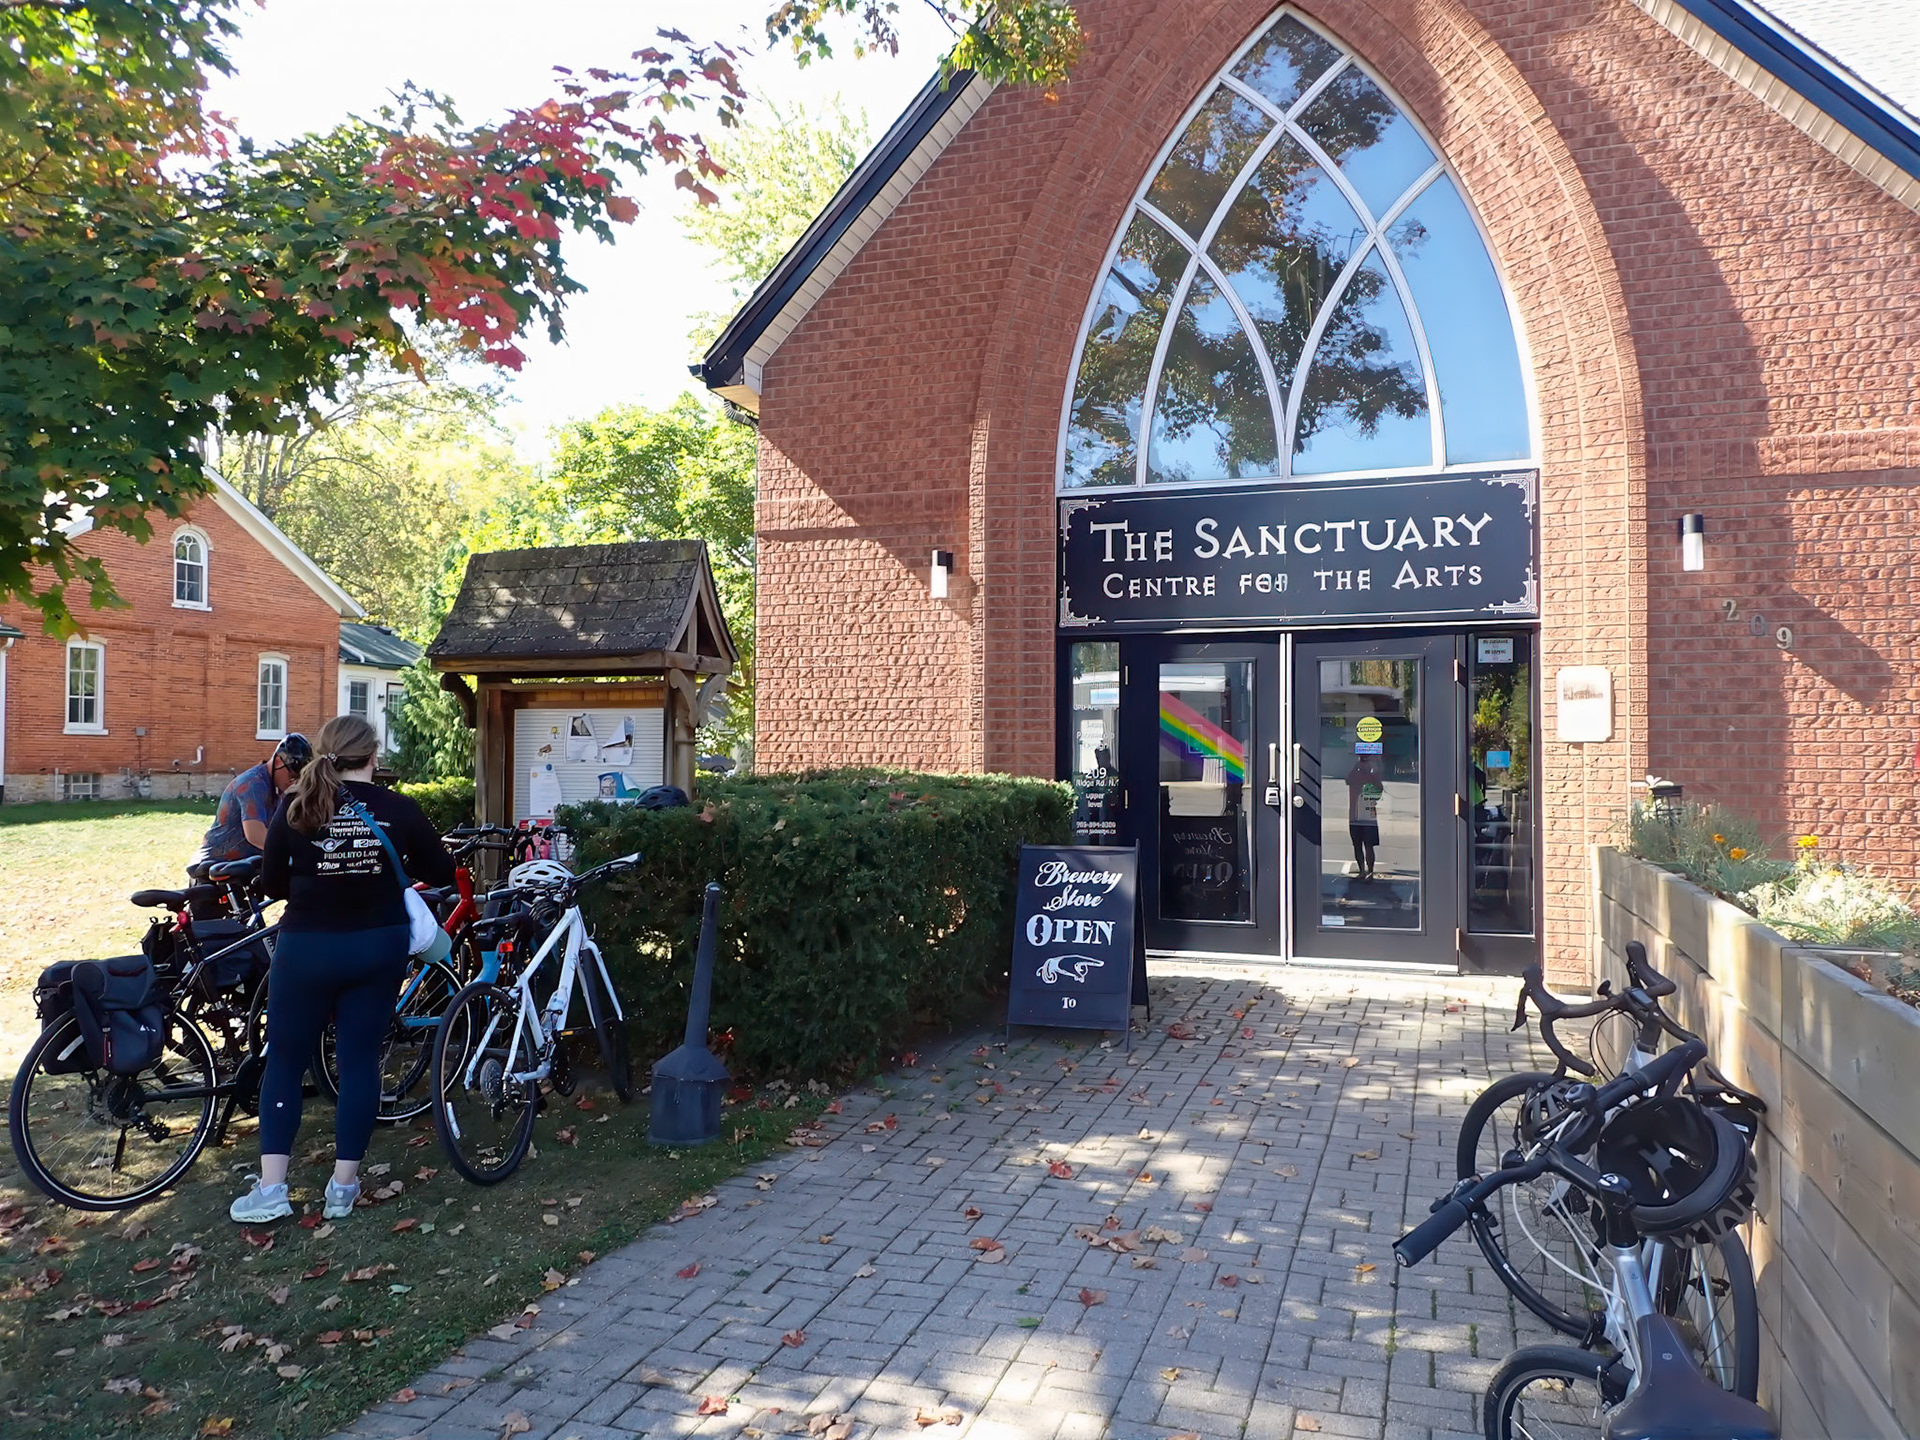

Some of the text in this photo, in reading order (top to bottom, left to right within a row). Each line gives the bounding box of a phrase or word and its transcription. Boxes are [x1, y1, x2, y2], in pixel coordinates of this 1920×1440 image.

[1722, 599, 1793, 649] 209
[1034, 861, 1123, 894] Brewery
[1042, 884, 1103, 911] Store
